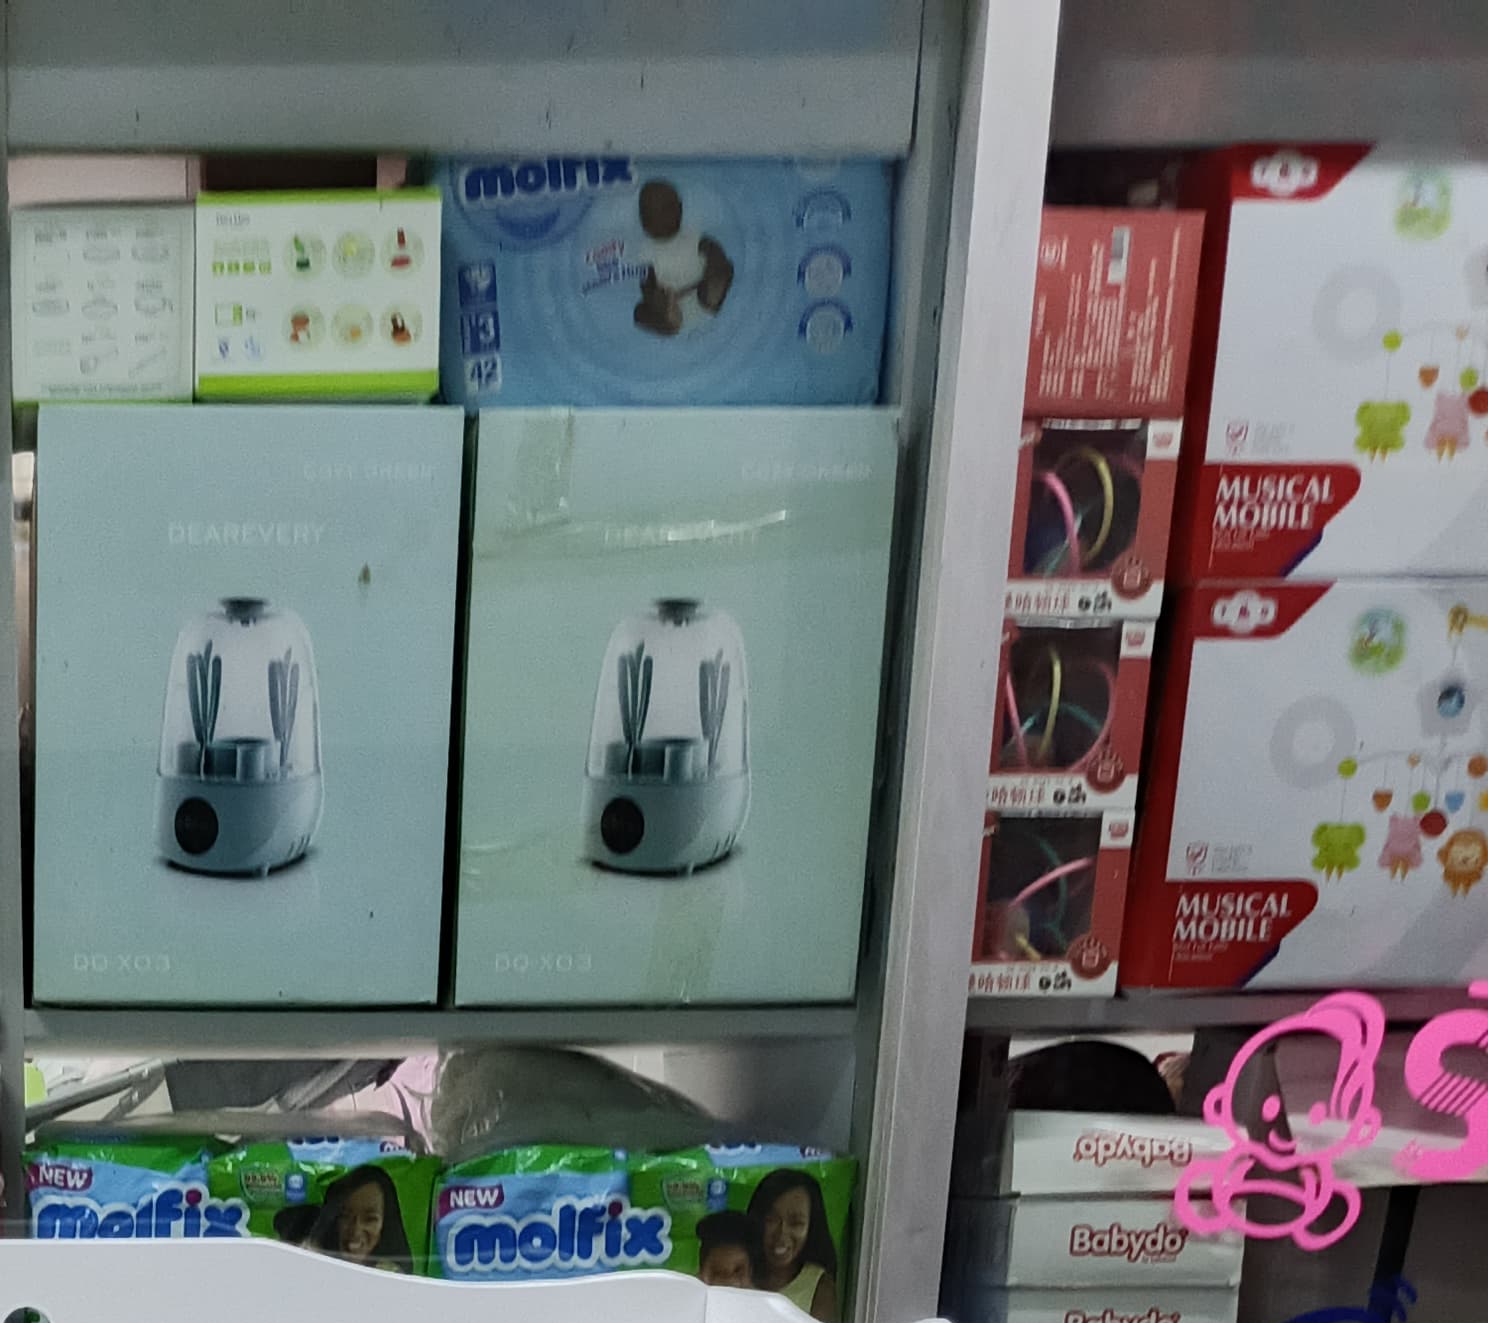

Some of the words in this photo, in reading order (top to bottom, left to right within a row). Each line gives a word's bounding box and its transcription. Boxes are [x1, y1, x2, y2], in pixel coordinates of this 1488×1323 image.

[1215, 474, 1335, 504] MUSICAL
[1175, 891, 1292, 919] MUSICAL
[1172, 917, 1274, 943] MOBILE
[38, 1165, 89, 1189] NEW
[449, 1187, 500, 1208] NEW
[36, 1187, 244, 1239] molfix
[453, 1195, 666, 1266] molfix
[1069, 1224, 1188, 1262] Babydo
